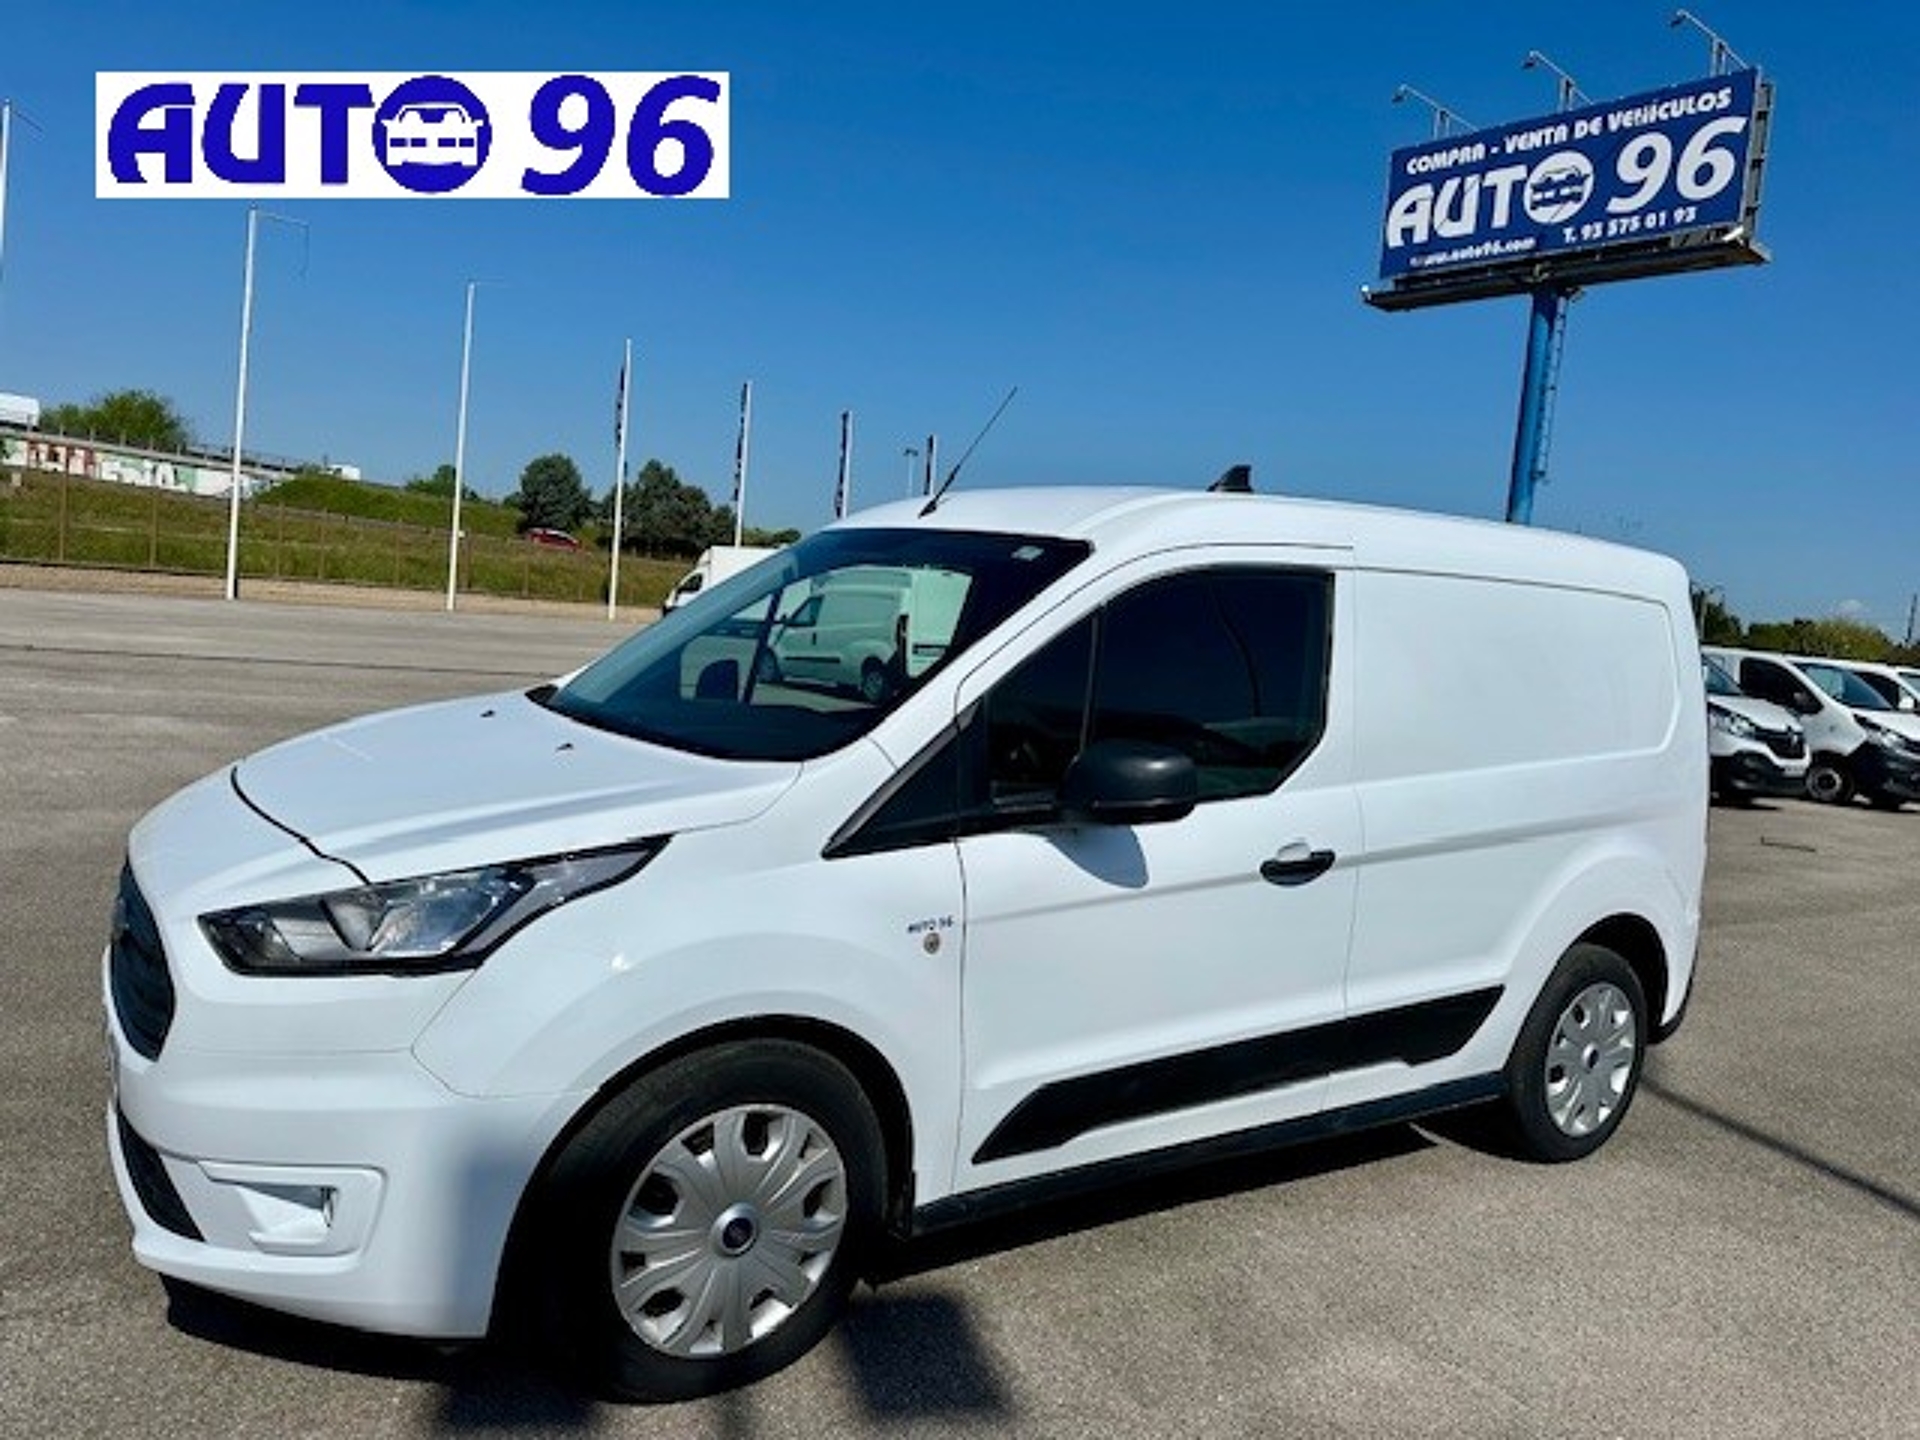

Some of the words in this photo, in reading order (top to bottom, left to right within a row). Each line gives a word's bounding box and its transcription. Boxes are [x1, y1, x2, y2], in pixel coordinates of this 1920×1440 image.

[1406, 142, 1486, 175] COMPRA
[1504, 124, 1568, 154] VENTA
[1574, 116, 1603, 139] DE
[1387, 151, 1594, 248] AUTO
[1606, 116, 1748, 214] 96
[1563, 227, 1577, 243] T.
[1580, 222, 1603, 241] 93
[1607, 215, 1641, 237] 575
[1645, 211, 1667, 229] 01
[1674, 206, 1697, 225] 93
